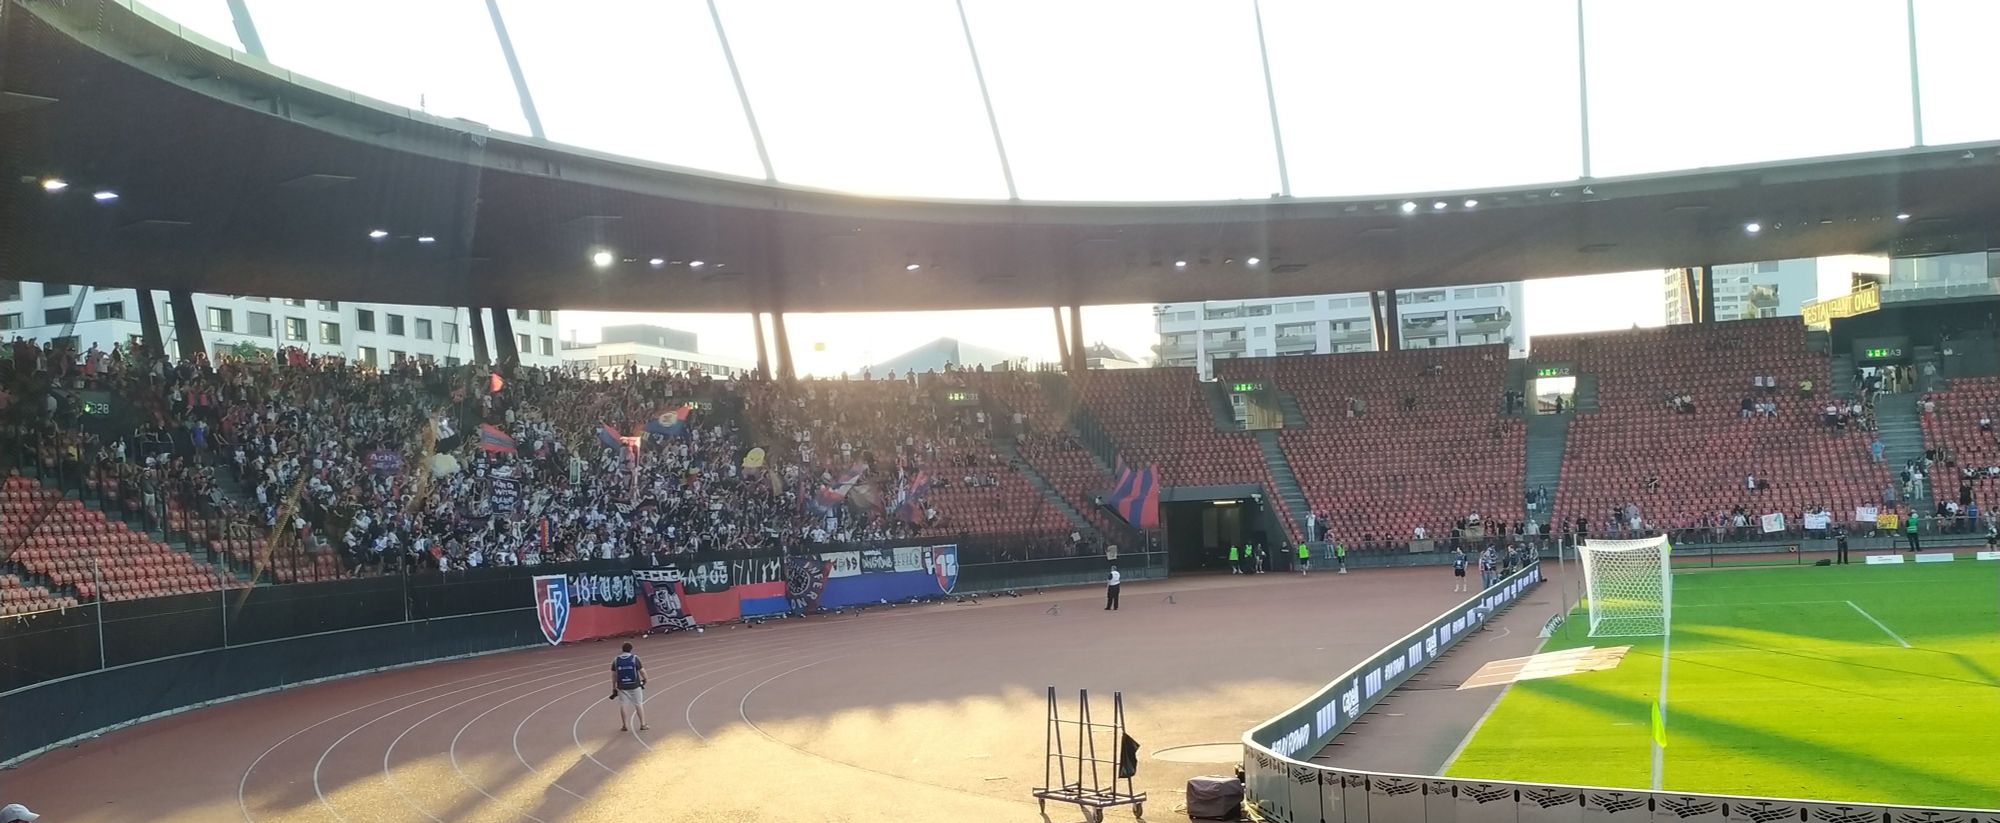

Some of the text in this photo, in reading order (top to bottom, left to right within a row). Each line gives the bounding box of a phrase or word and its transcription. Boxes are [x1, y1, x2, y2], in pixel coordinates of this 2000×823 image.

[1854, 290, 1878, 312] OVAL
[1891, 348, 1902, 356] A3
[935, 554, 956, 577] 12
